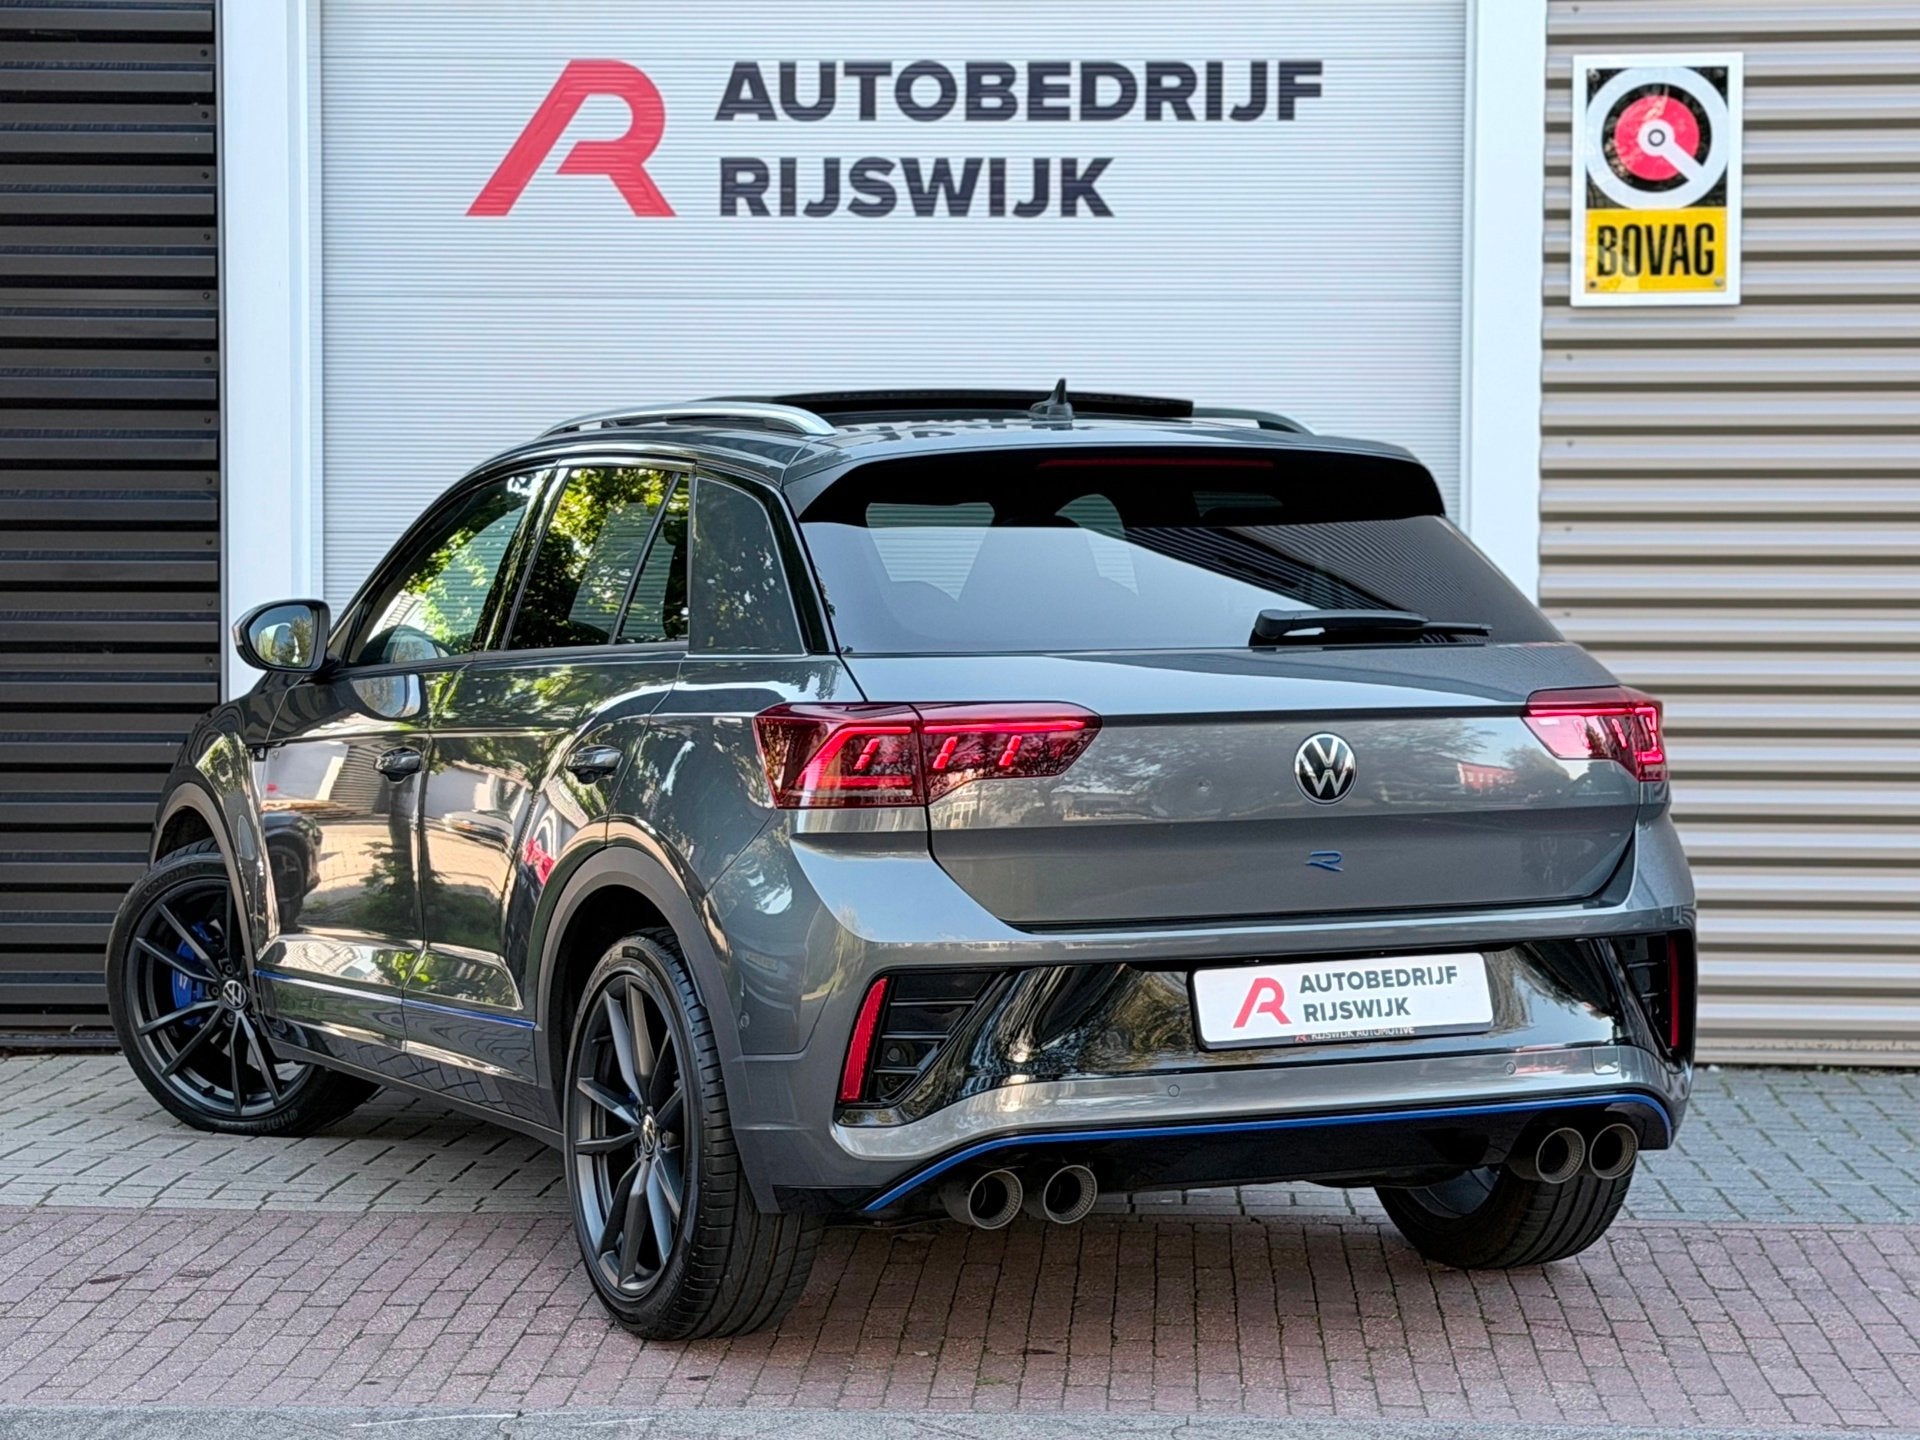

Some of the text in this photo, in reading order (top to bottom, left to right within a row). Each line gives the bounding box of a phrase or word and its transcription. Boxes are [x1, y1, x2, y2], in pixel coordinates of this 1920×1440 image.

[714, 59, 1324, 122] AUTOBEDRIJF
[719, 156, 1116, 218] RIJSWIJK
[1597, 222, 1715, 277] BOVAG
[1299, 965, 1458, 994] AUTOBEDRIJF
[1303, 997, 1411, 1023] RIJSWIJK
